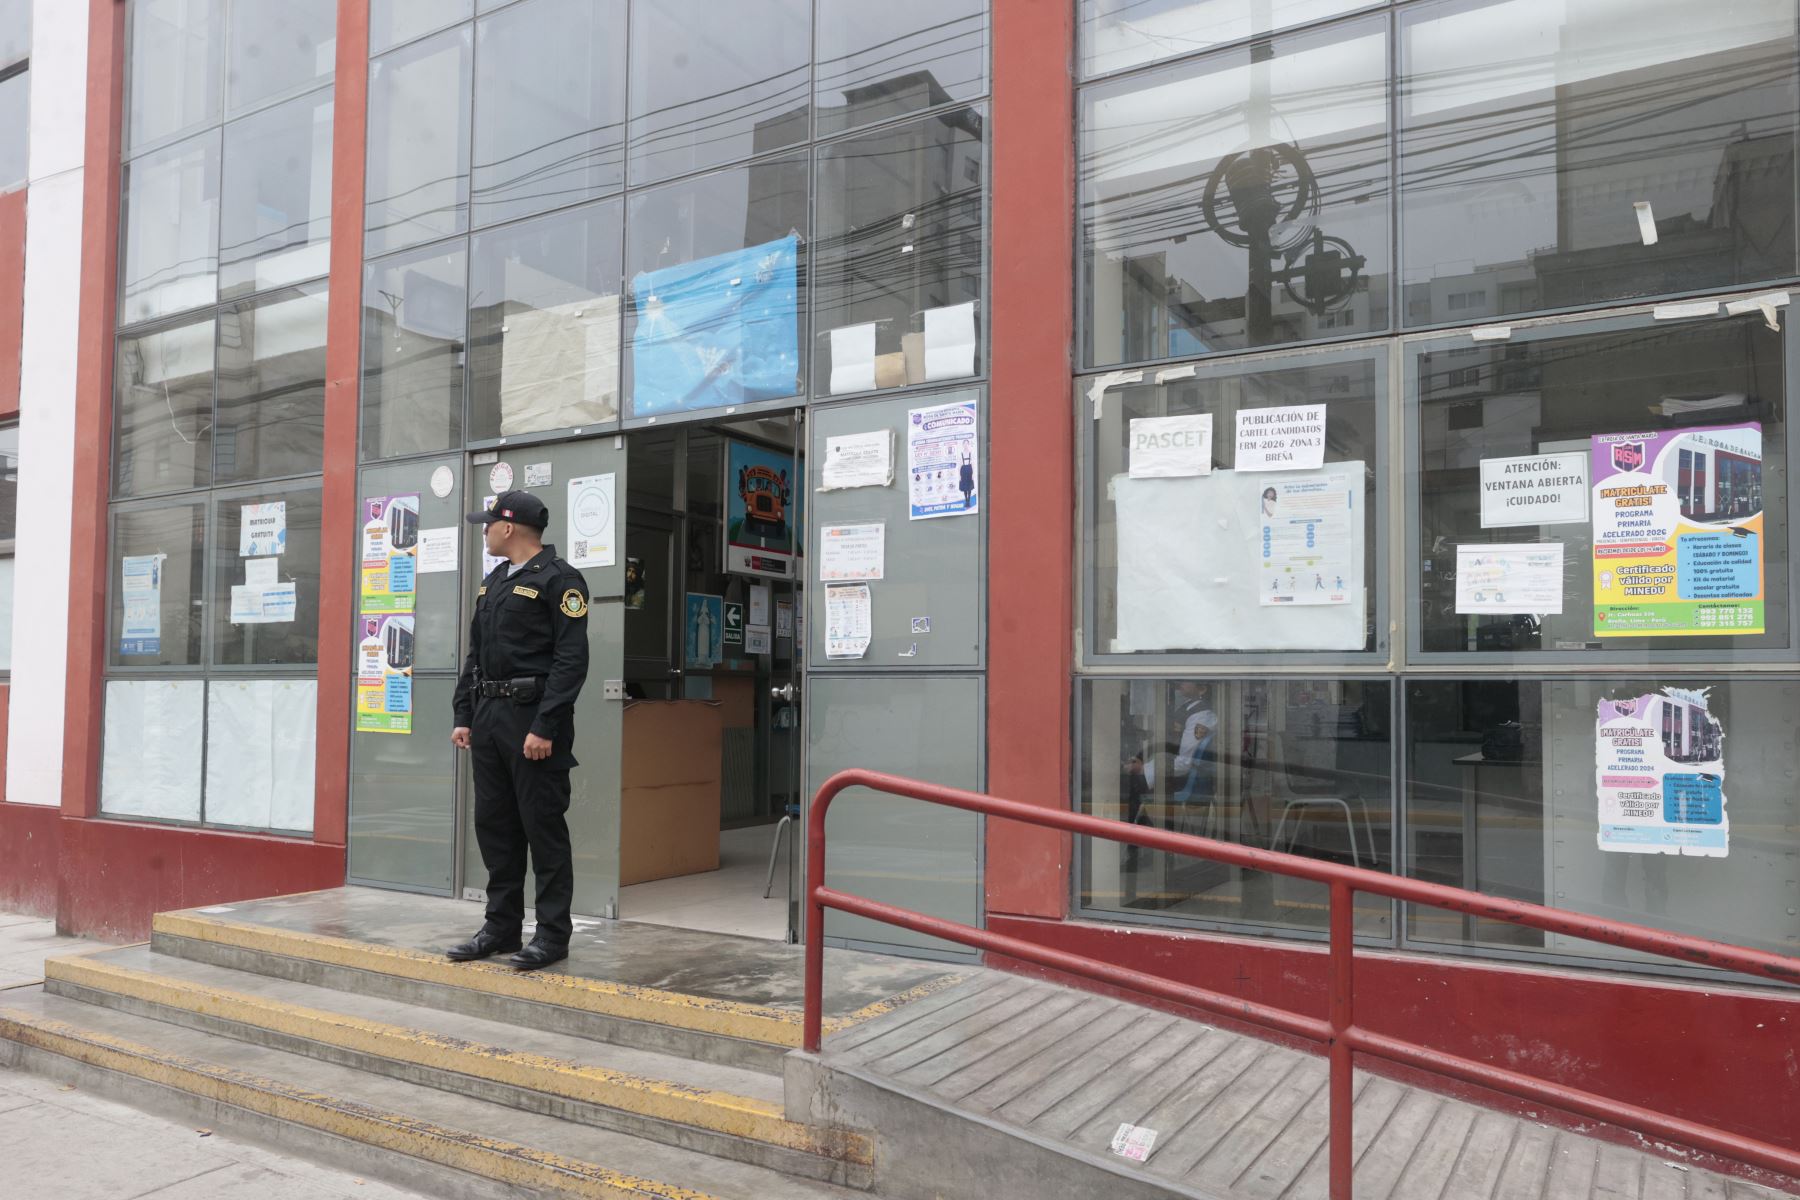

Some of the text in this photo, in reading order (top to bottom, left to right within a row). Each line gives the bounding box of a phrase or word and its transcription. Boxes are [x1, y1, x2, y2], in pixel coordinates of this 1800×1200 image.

[1242, 411, 1320, 425] PUBLICACIÓN DE
[1240, 425, 1322, 437] CARTEL CANDIDATOS
[1136, 430, 1207, 450] PASCET
[1240, 442, 1257, 450] ERM
[1290, 438, 1312, 447] ZONA
[1316, 437, 1321, 446] 3
[1265, 450, 1293, 461] BREÑA
[1615, 448, 1642, 465] RSM
[1505, 459, 1561, 474] ATENCIÓN:
[1485, 475, 1583, 491] VENTANA ABIERTA
[1600, 484, 1668, 499] ¡MATRICÚLATE
[1506, 493, 1561, 507] ¡CUIDADO!
[1615, 496, 1653, 508] GRATIS!
[1615, 510, 1654, 518] PROGRAMA
[1617, 520, 1651, 528] PRIMARIA
[1602, 528, 1667, 538] ACELERADO 2026
[1616, 564, 1676, 575] Certificado
[1619, 576, 1674, 586] válido por
[1624, 586, 1665, 596] MINEDU
[1601, 727, 1654, 738] ¡MATRICÚLATE
[1612, 738, 1642, 747] GRATIS!
[1618, 792, 1661, 800] Certificado
[1622, 809, 1654, 817] MINEDU
